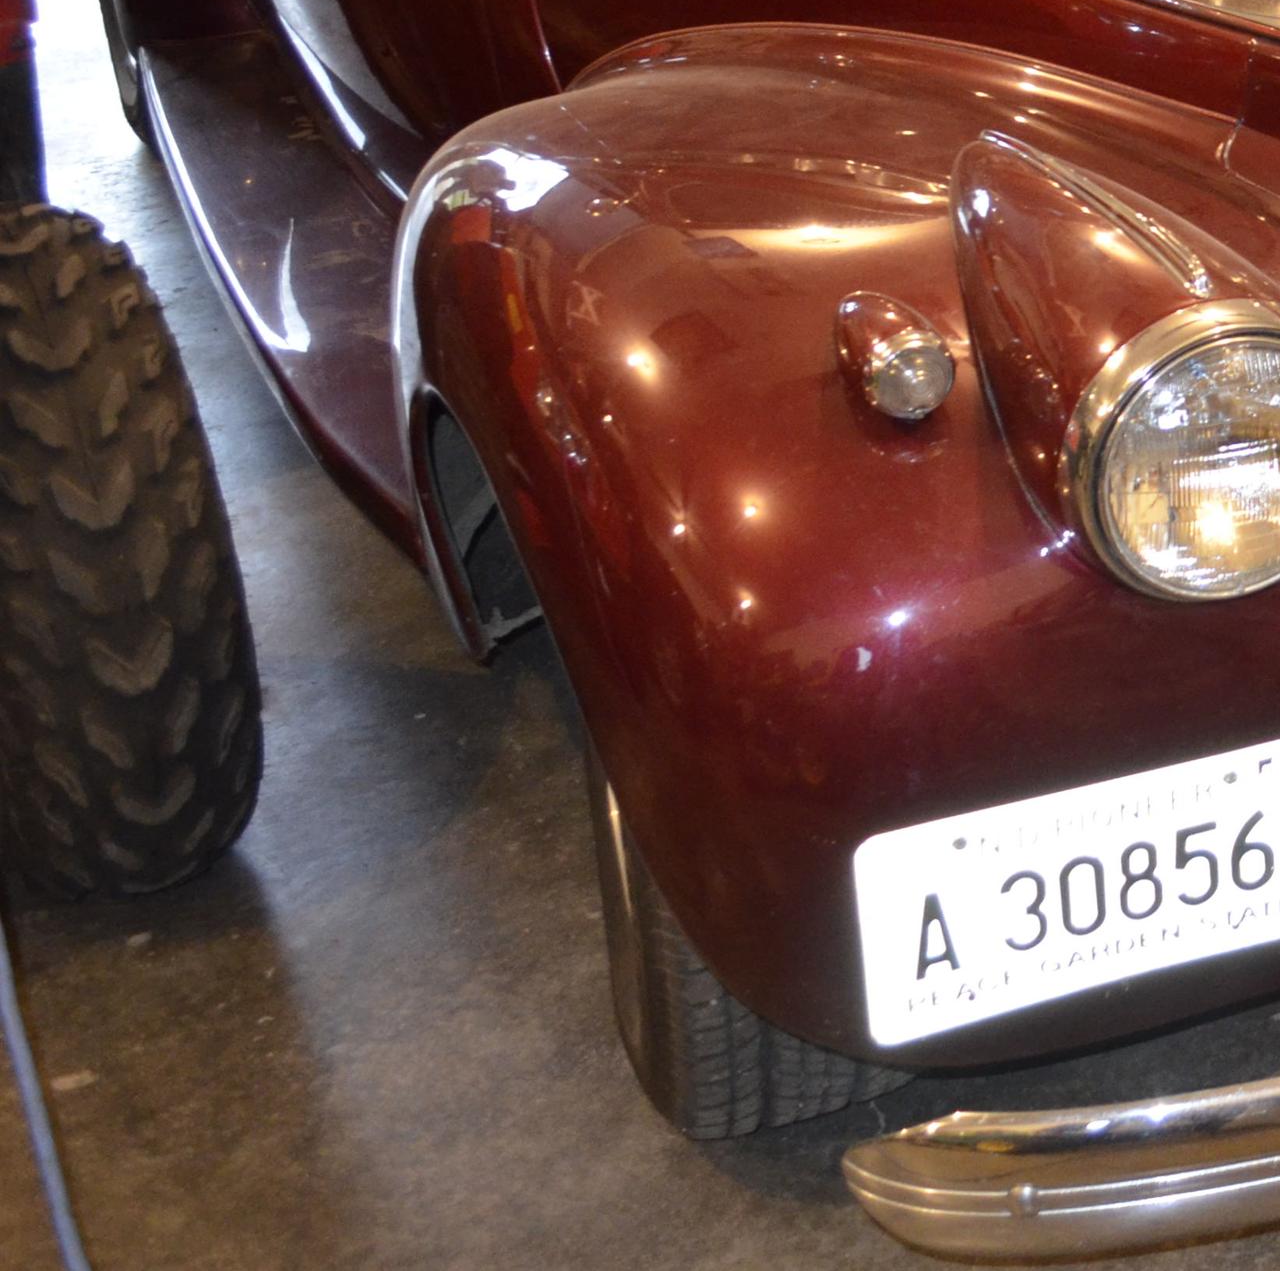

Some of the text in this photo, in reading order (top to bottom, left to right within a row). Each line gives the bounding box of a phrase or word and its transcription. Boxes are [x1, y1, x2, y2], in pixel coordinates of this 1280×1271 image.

[916, 810, 1275, 980] A 30856
[908, 971, 1013, 1012] PEACE
[1041, 926, 1181, 974] GARDEN
